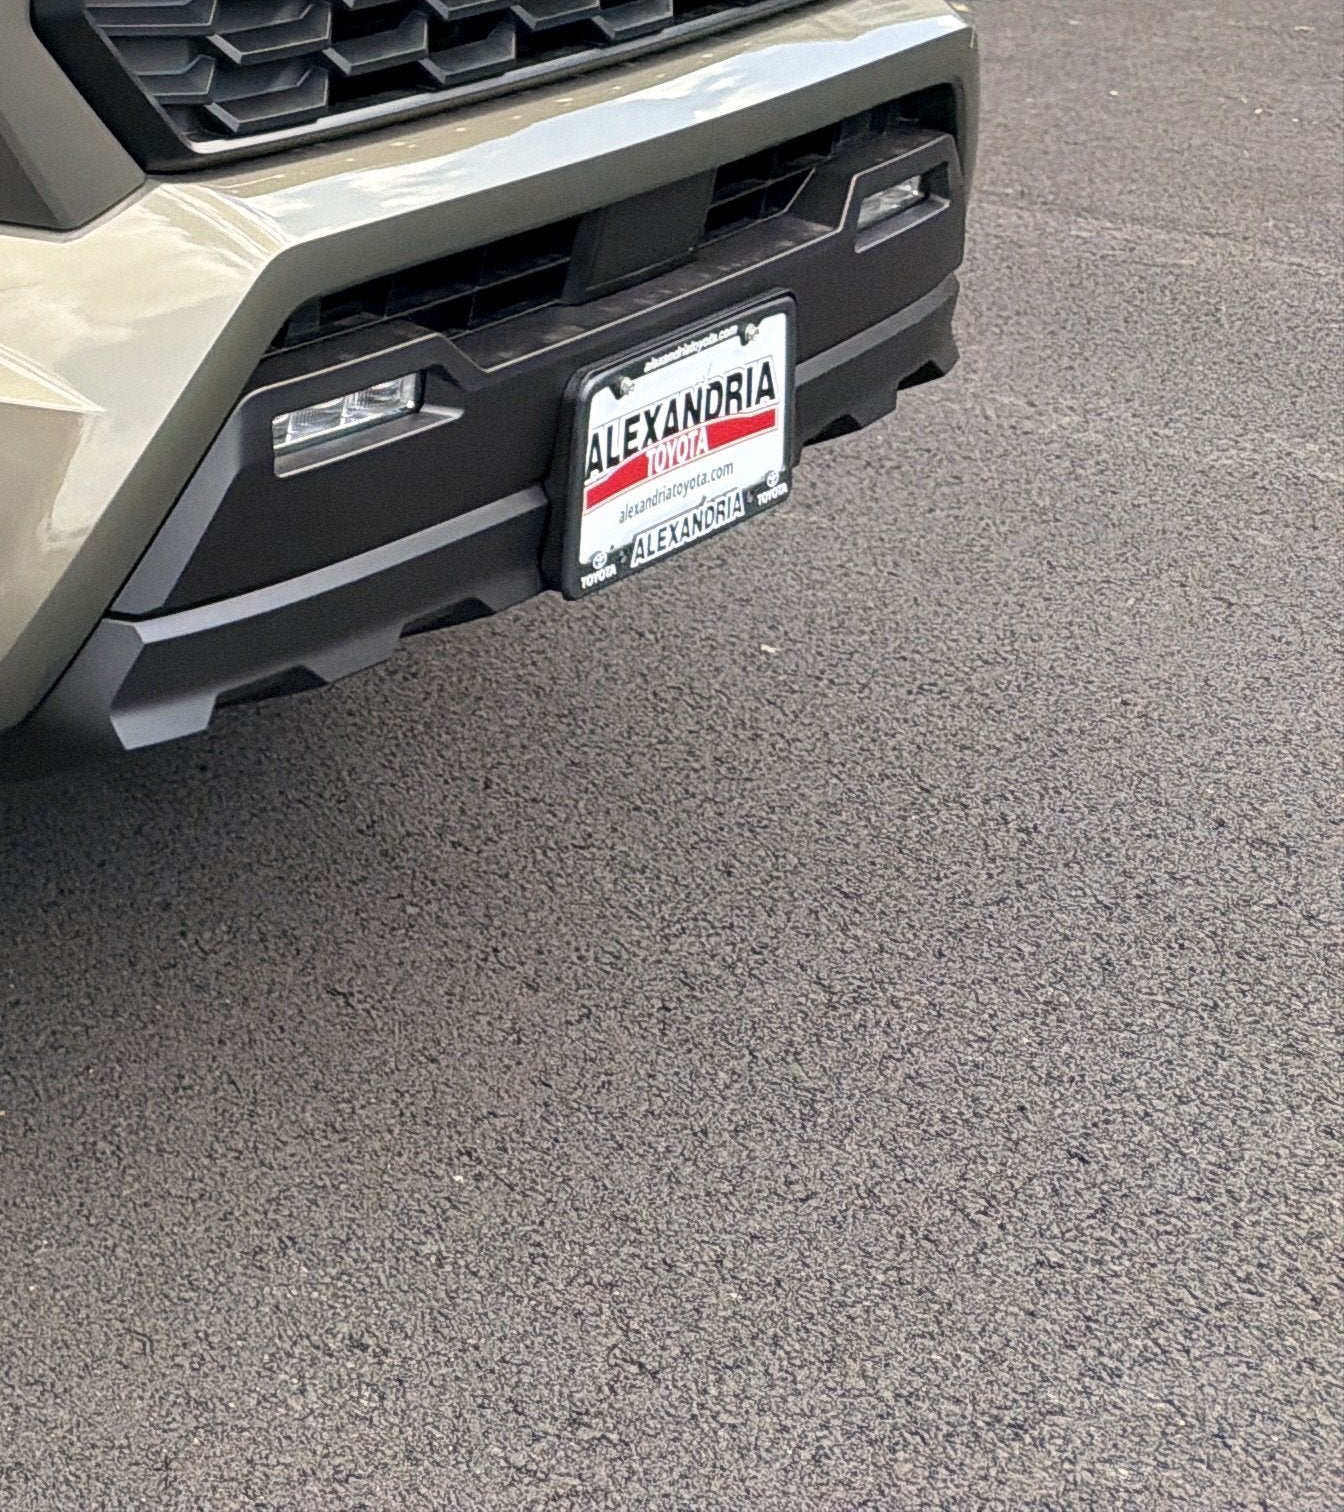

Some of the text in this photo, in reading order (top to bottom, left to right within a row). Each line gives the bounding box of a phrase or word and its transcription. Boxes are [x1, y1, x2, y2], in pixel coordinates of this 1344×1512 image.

[584, 361, 776, 479] ALEXANDRIA
[645, 427, 709, 478] TOYOTA
[619, 460, 734, 524] alexandriatoyota.com
[756, 483, 788, 506] TOYOTA
[633, 494, 743, 565] ALEXANDRIA
[581, 566, 617, 589] TOYOTA
